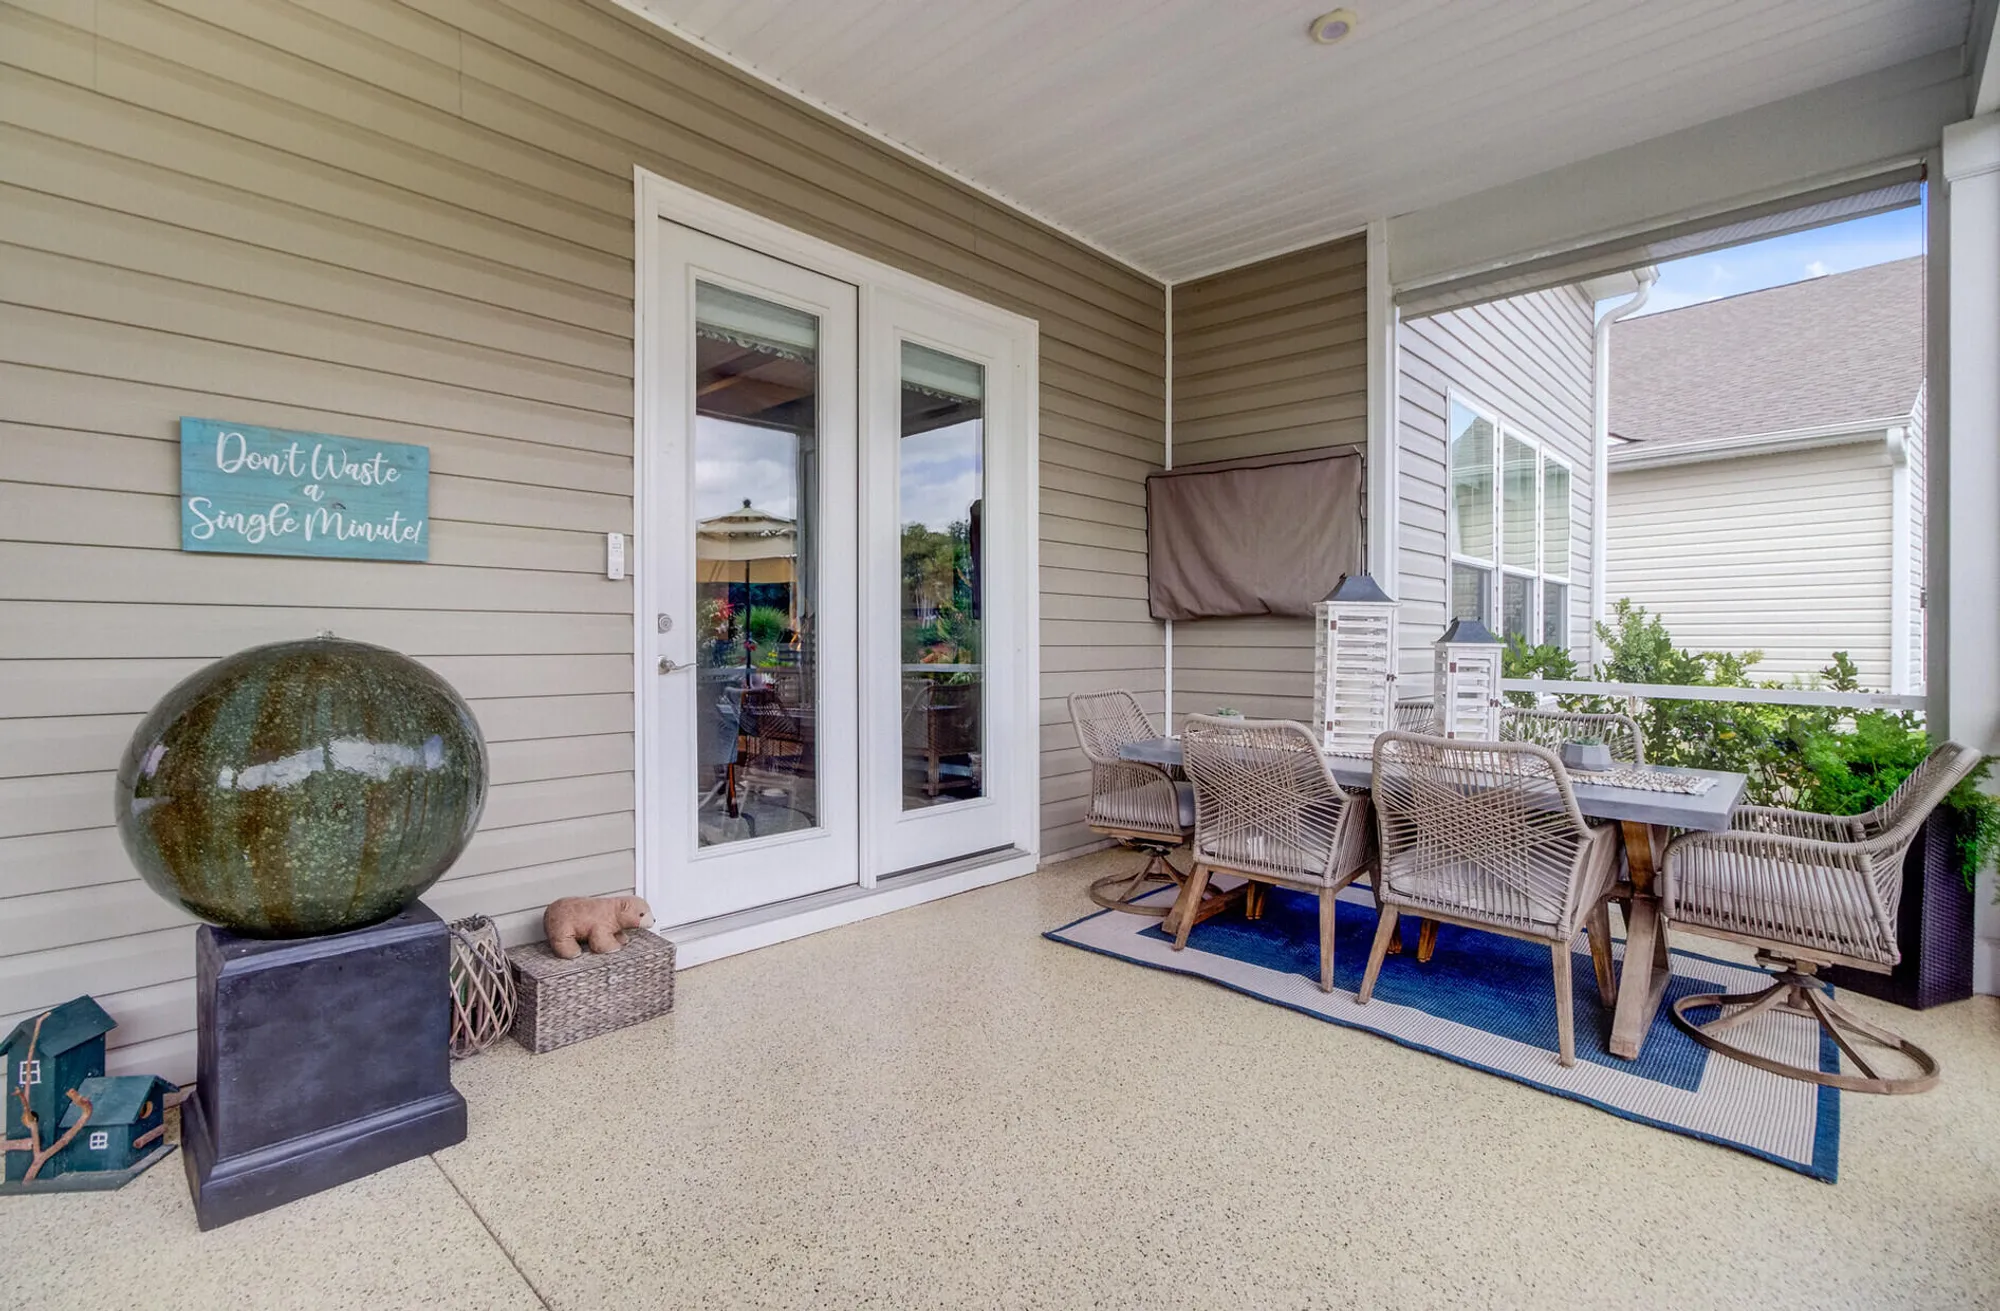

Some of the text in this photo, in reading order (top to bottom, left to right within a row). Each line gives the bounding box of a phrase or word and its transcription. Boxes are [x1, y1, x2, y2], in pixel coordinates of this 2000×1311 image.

[216, 431, 400, 486] Don't Waste
[303, 483, 324, 501] a
[188, 496, 300, 544] Single
